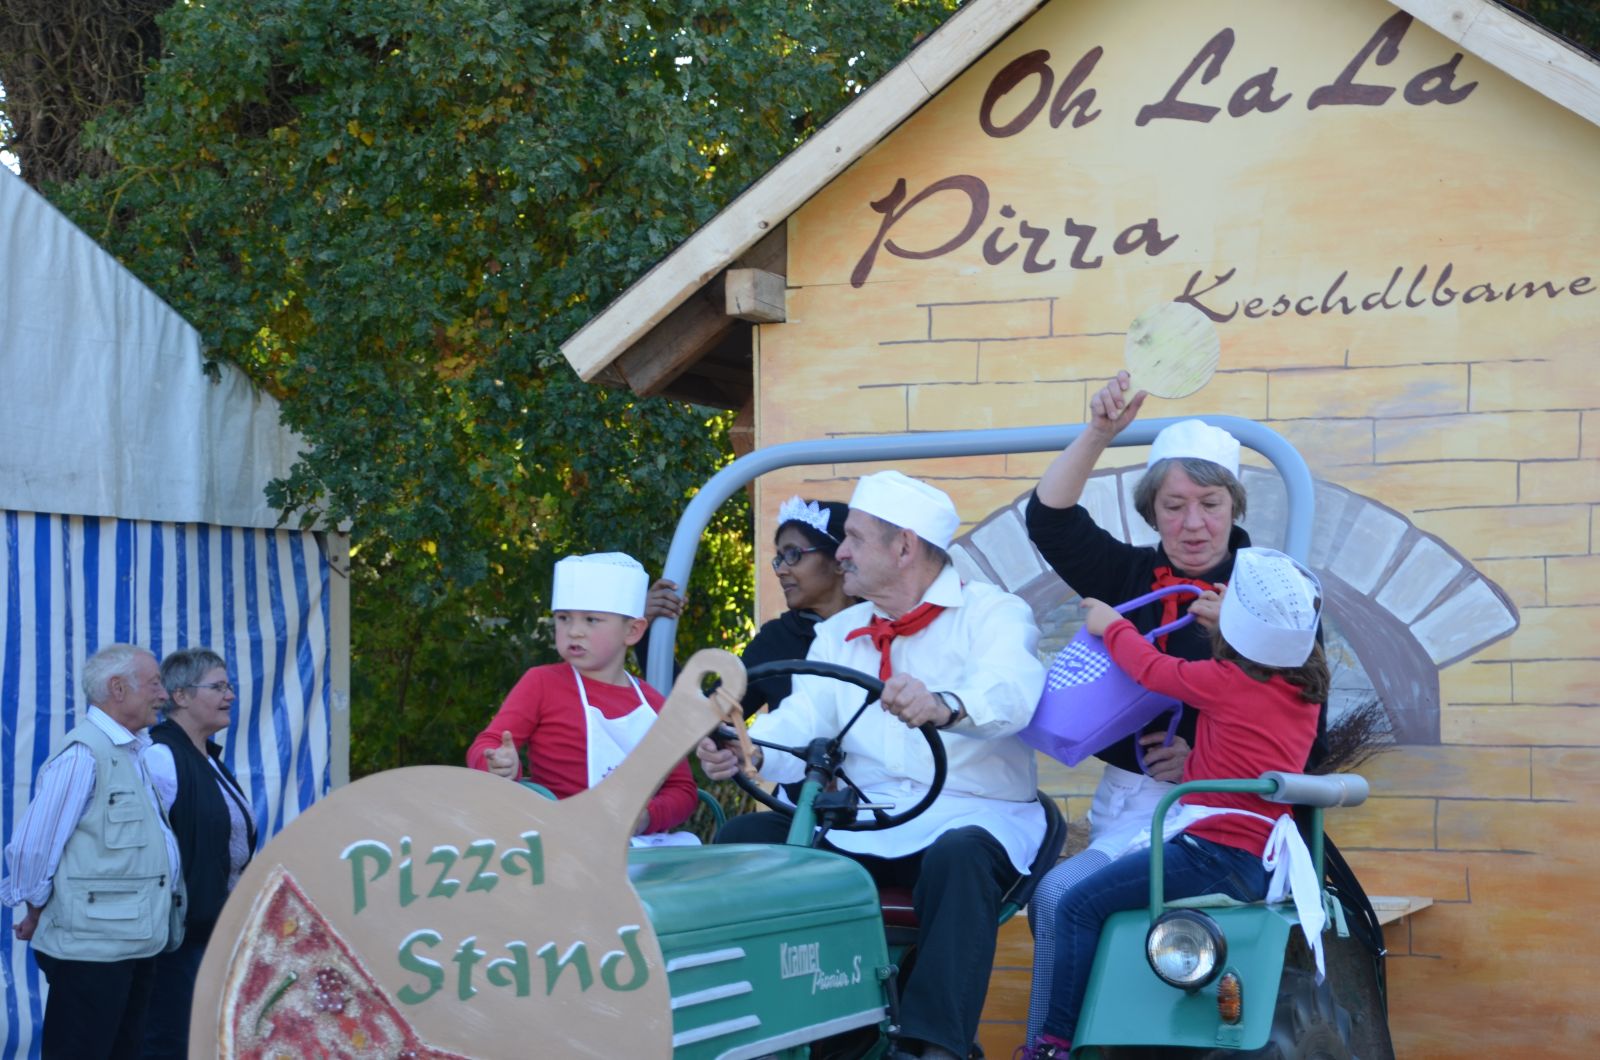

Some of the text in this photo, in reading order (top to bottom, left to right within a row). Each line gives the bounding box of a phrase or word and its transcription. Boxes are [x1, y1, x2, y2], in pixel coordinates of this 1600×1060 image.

[979, 11, 1479, 138] Oh La La
[1173, 262, 1598, 323] Keschdlbame
[340, 830, 545, 915] Pizza
[396, 925, 649, 1005] Stand
[780, 942, 820, 980] Kramer
[851, 955, 862, 984] S
